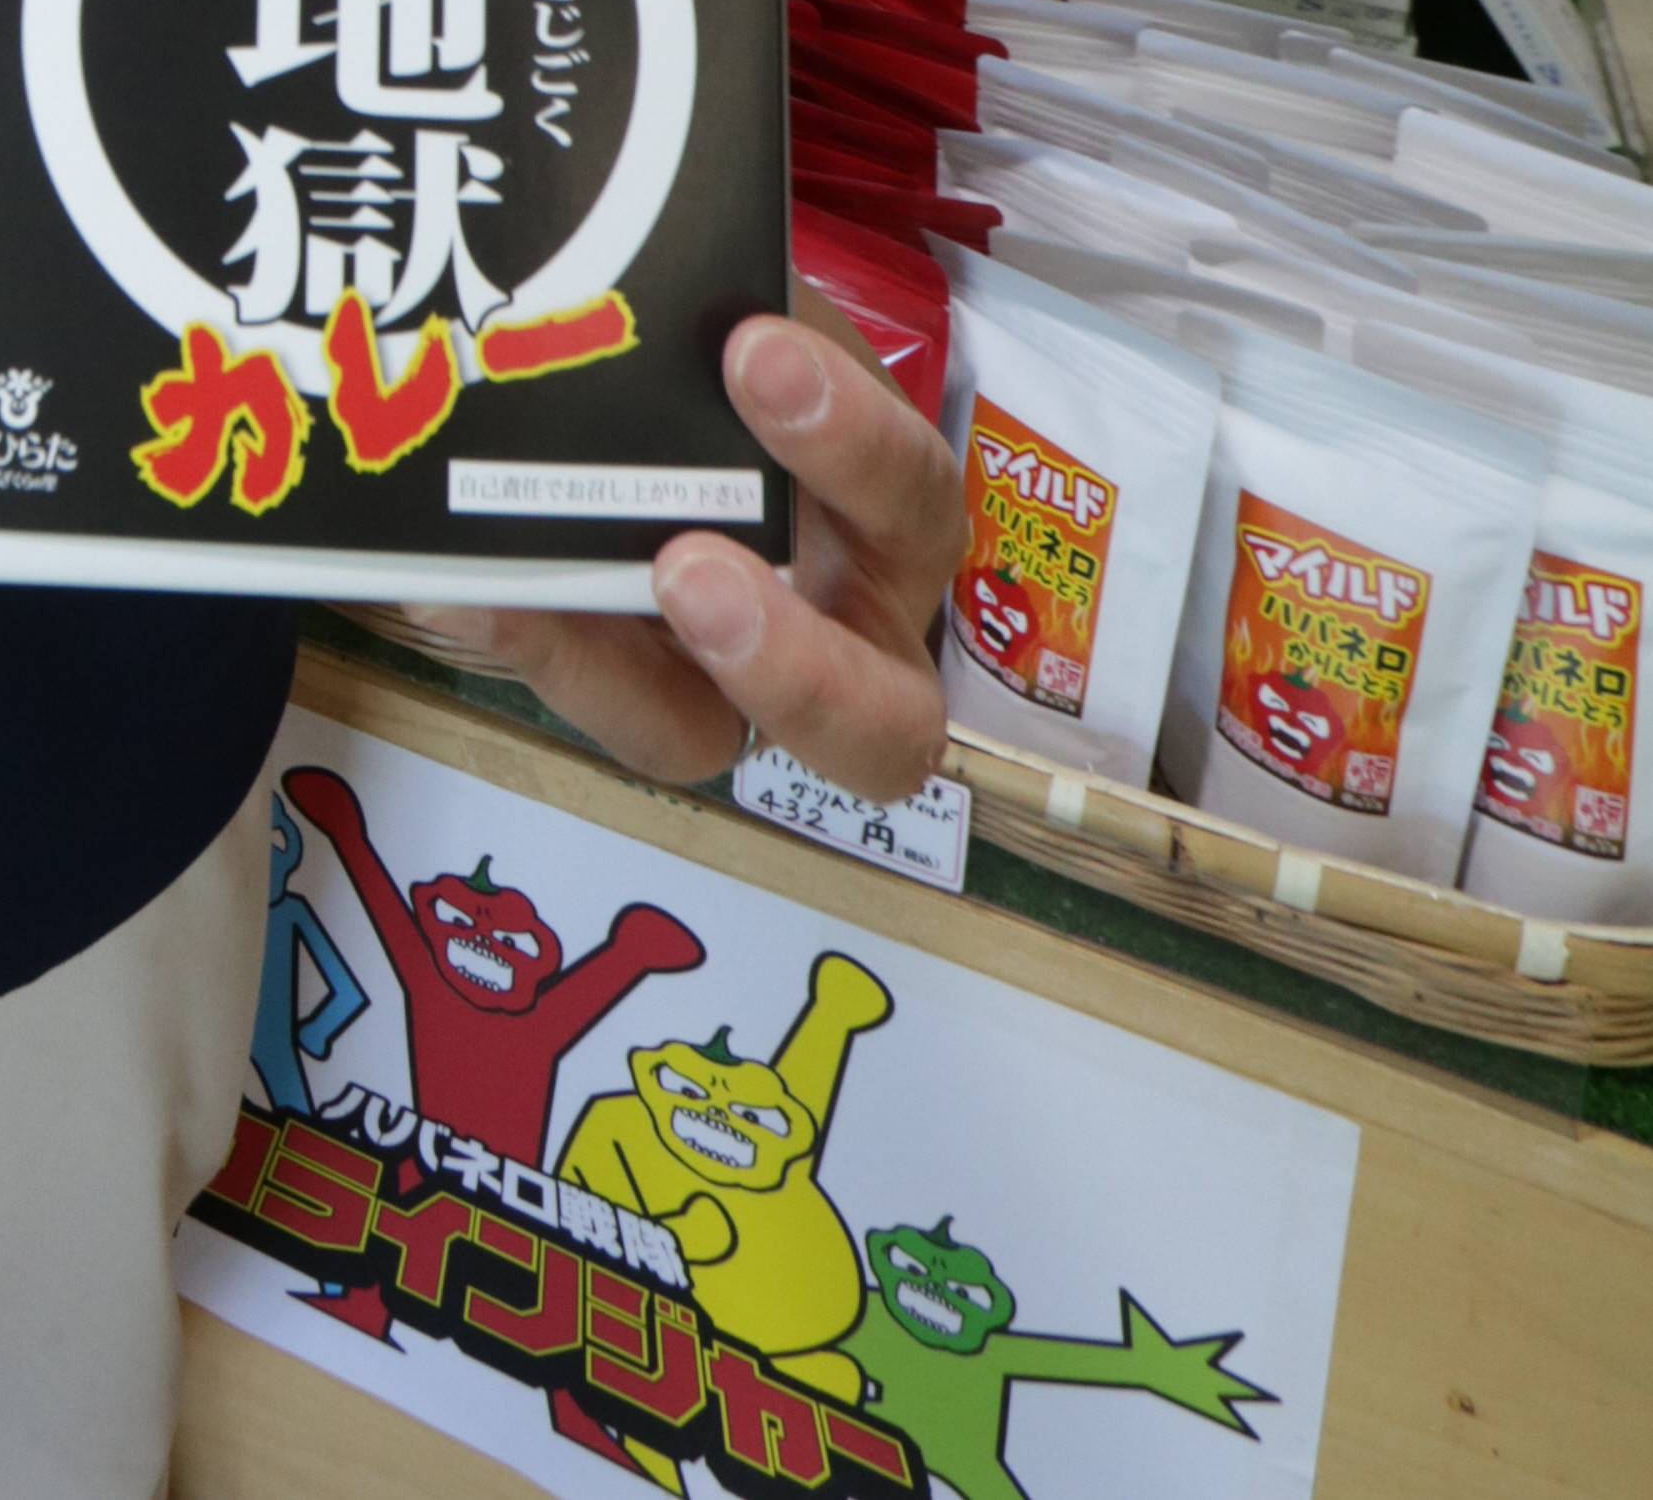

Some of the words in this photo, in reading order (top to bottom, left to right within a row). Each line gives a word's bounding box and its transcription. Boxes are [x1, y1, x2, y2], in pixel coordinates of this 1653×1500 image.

[130, 287, 641, 517] カレー
[975, 433, 1107, 528] マイルド
[984, 490, 1099, 582] ハバネロ
[999, 537, 1092, 609] かりんとう
[1242, 531, 1419, 623] マイルド
[1262, 593, 1410, 675] ハバネロ
[1286, 639, 1401, 701] かりんとう
[757, 788, 830, 834] 432
[317, 1080, 690, 1290] ハバネロ戦隊
